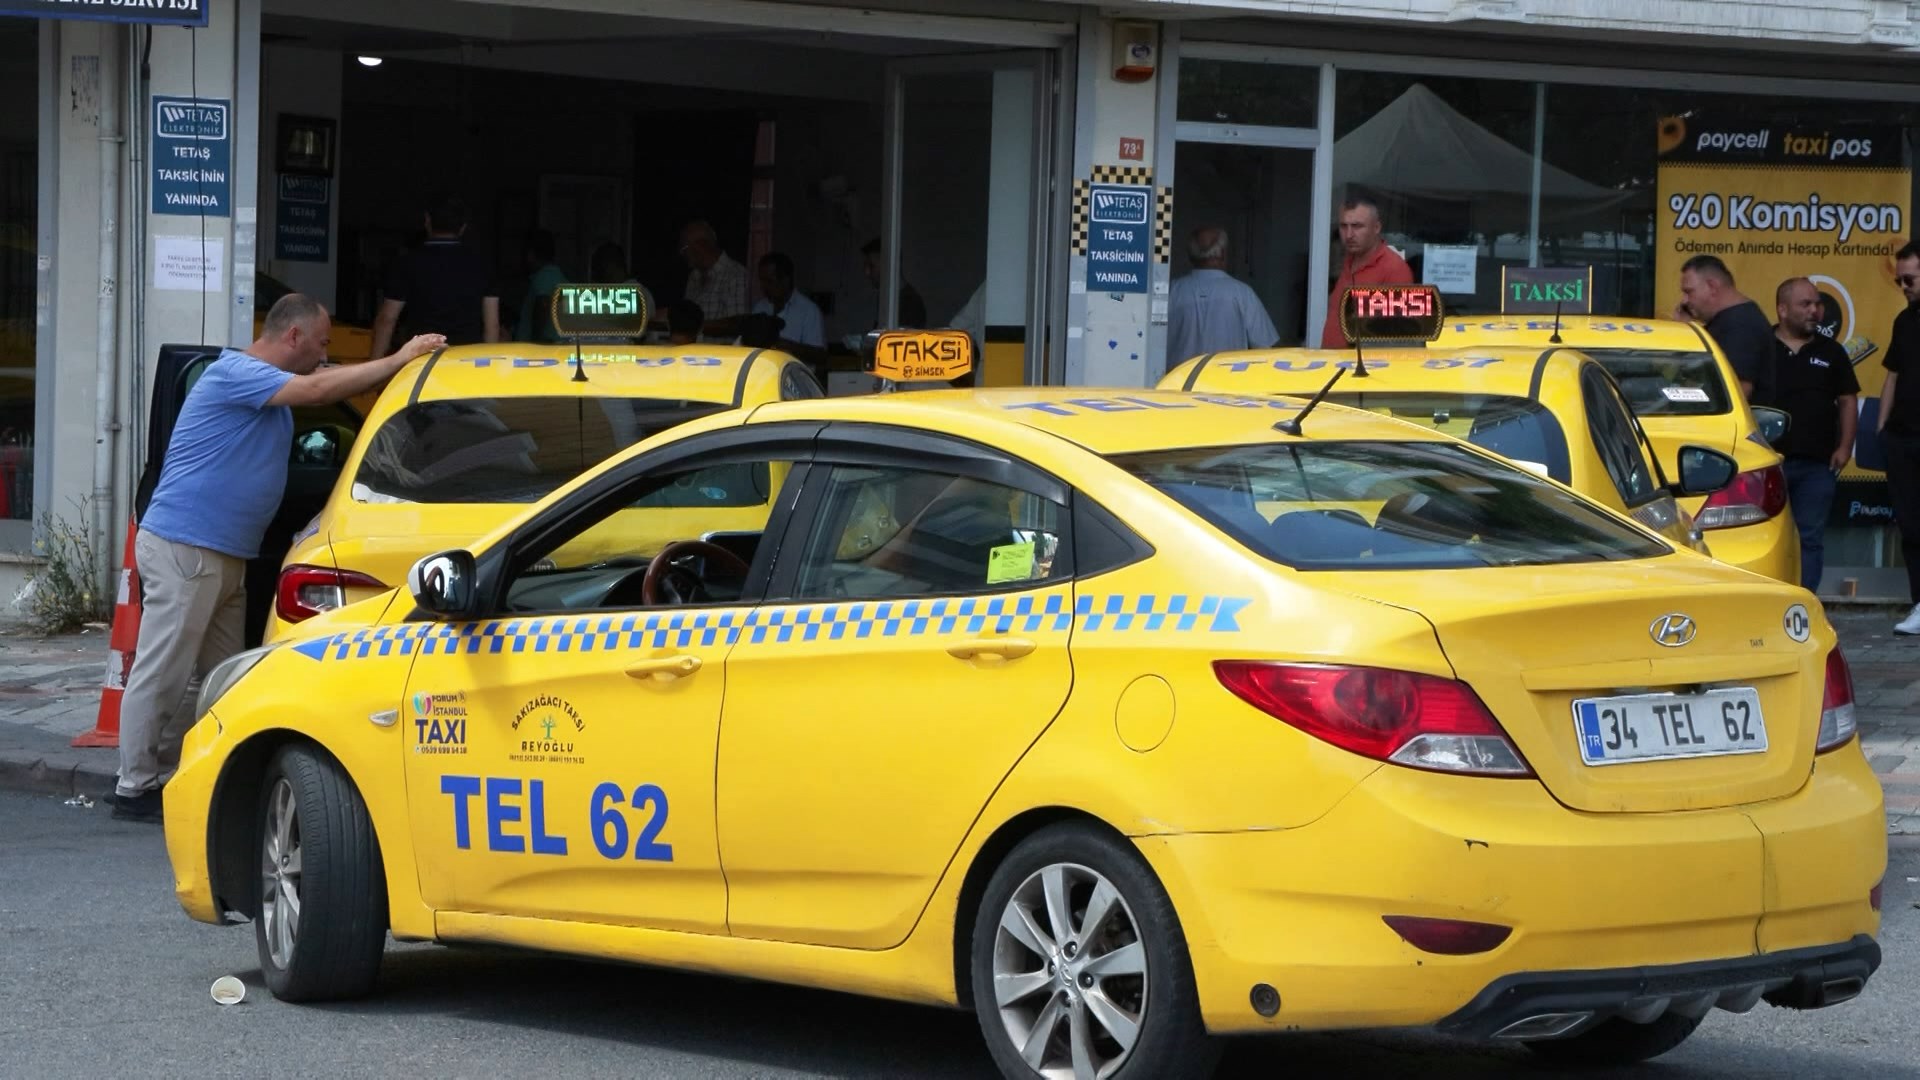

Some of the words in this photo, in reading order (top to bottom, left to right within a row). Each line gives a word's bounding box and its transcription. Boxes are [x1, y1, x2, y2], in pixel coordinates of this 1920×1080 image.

[185, 109, 221, 125] TETAŞ
[1697, 130, 1769, 152] paycell
[172, 146, 211, 160] TETAŞ
[157, 169, 225, 183] TAKSİCİNİN
[164, 193, 218, 206] YANINDA
[1115, 197, 1143, 210] TETAŞ
[1669, 193, 1723, 229] %0
[1728, 192, 1902, 243] Komisyon
[1103, 229, 1133, 243] TETAŞ
[1674, 237, 1734, 254] Ödemen
[1738, 240, 1784, 255] Anında
[1788, 242, 1830, 259] Hesap
[1833, 242, 1894, 257] Kartında!
[1091, 249, 1144, 263] TAKSİCİNİN
[1095, 272, 1138, 284] YANINDA
[1510, 278, 1583, 301] TAKSİ
[433, 705, 468, 716] İSTANBUL
[511, 693, 562, 731] SAKIZAĞACI
[415, 719, 466, 744] TAXI
[1601, 707, 1638, 750] 34
[1652, 703, 1705, 746] TEL
[1721, 700, 1755, 742] 62
[521, 739, 574, 753] BEYOĞLU
[1587, 735, 1601, 747] TR
[440, 774, 568, 856] TEL
[589, 781, 674, 863] 62
